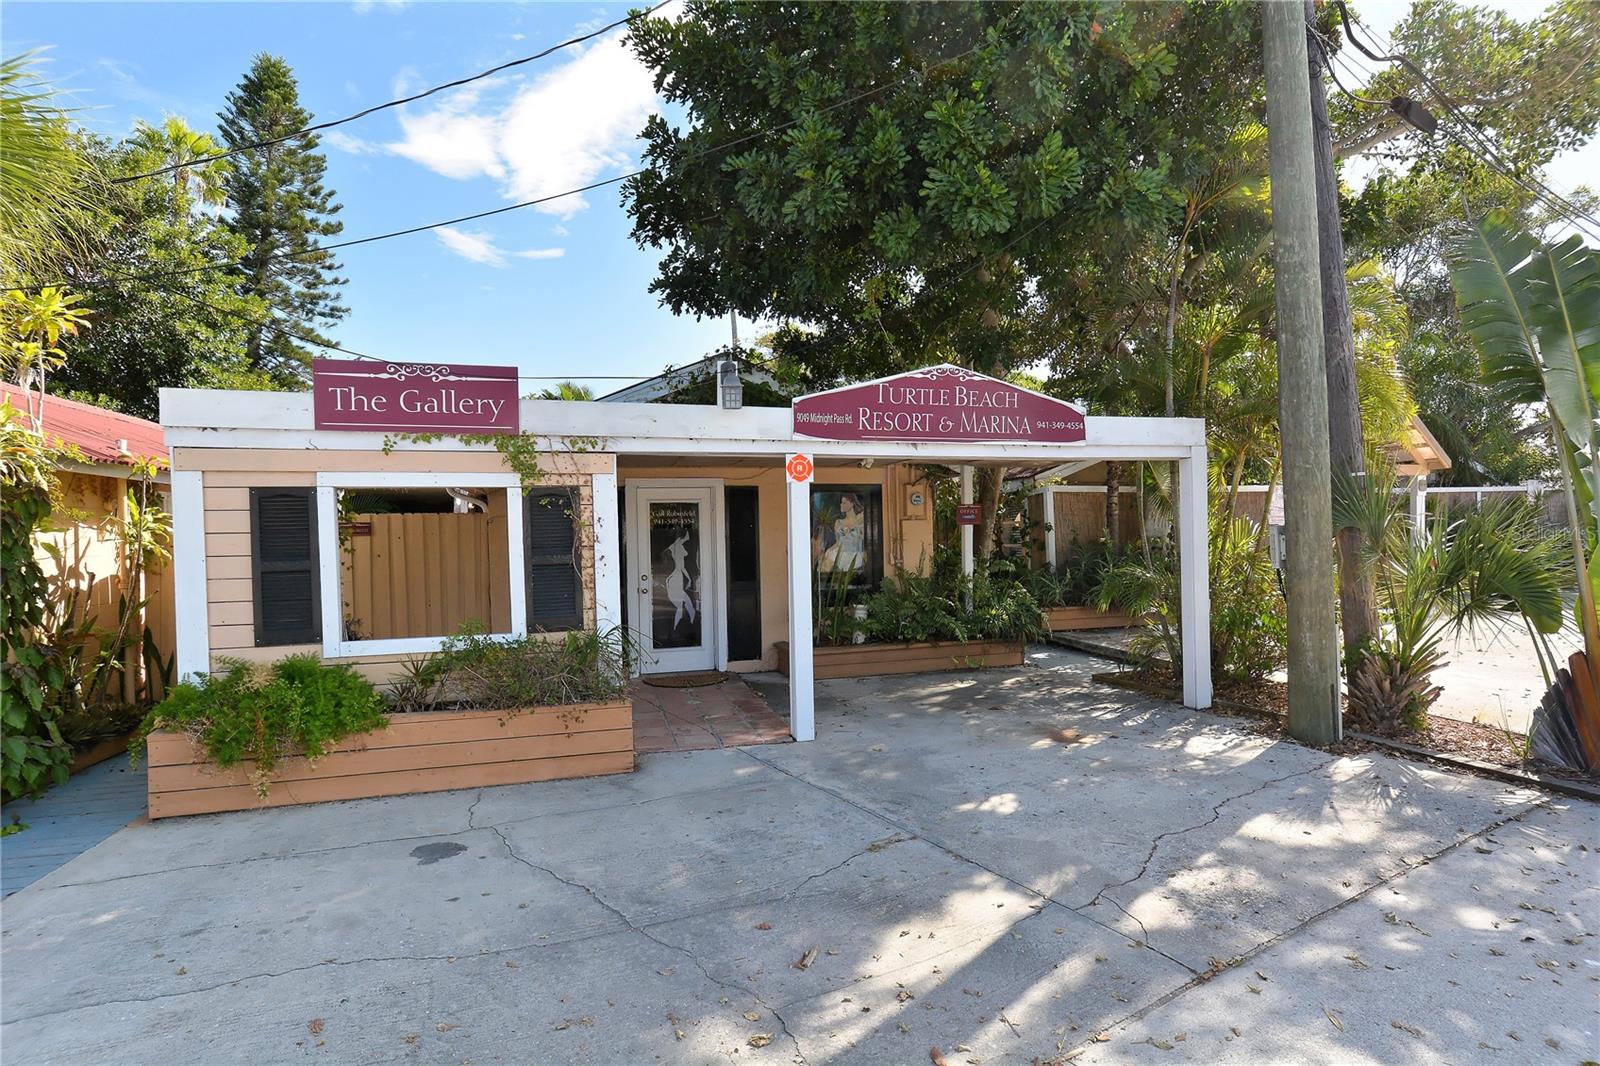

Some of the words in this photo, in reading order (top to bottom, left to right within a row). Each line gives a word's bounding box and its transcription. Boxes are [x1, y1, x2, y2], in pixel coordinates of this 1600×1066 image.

[328, 386, 387, 412] The
[399, 388, 505, 423] Gallery
[875, 382, 950, 407] TURTLE
[955, 385, 1019, 408] BEACH
[796, 412, 810, 423] 9049
[810, 412, 833, 426] Midnight
[833, 413, 844, 424] Pass
[844, 413, 854, 424] Rd.
[857, 407, 933, 432] RESORT
[938, 416, 955, 433] &
[959, 411, 1032, 435] MARINA
[1036, 420, 1083, 430] 941-349-4554
